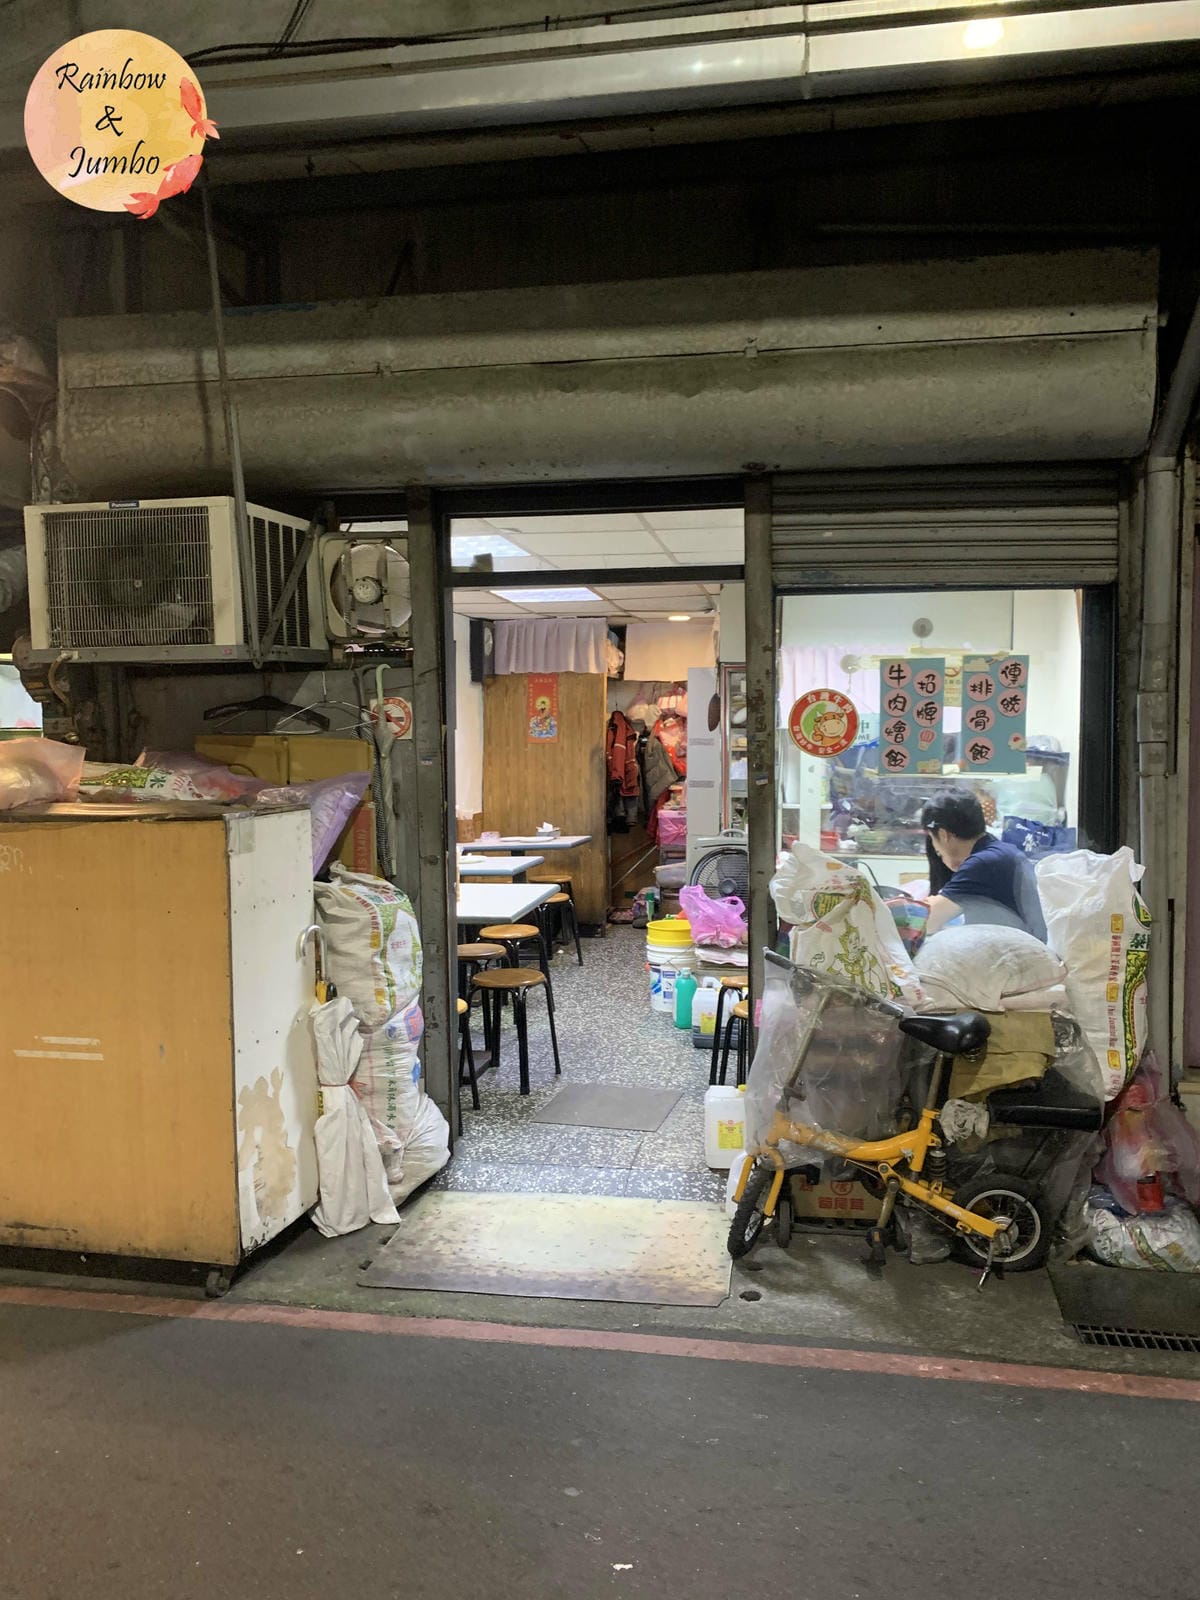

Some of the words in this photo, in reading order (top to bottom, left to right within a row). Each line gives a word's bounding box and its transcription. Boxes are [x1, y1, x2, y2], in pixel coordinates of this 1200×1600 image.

[917, 673, 938, 724] 招牌
[1001, 661, 1022, 713] 傳統
[969, 678, 993, 761] 排骨飯
